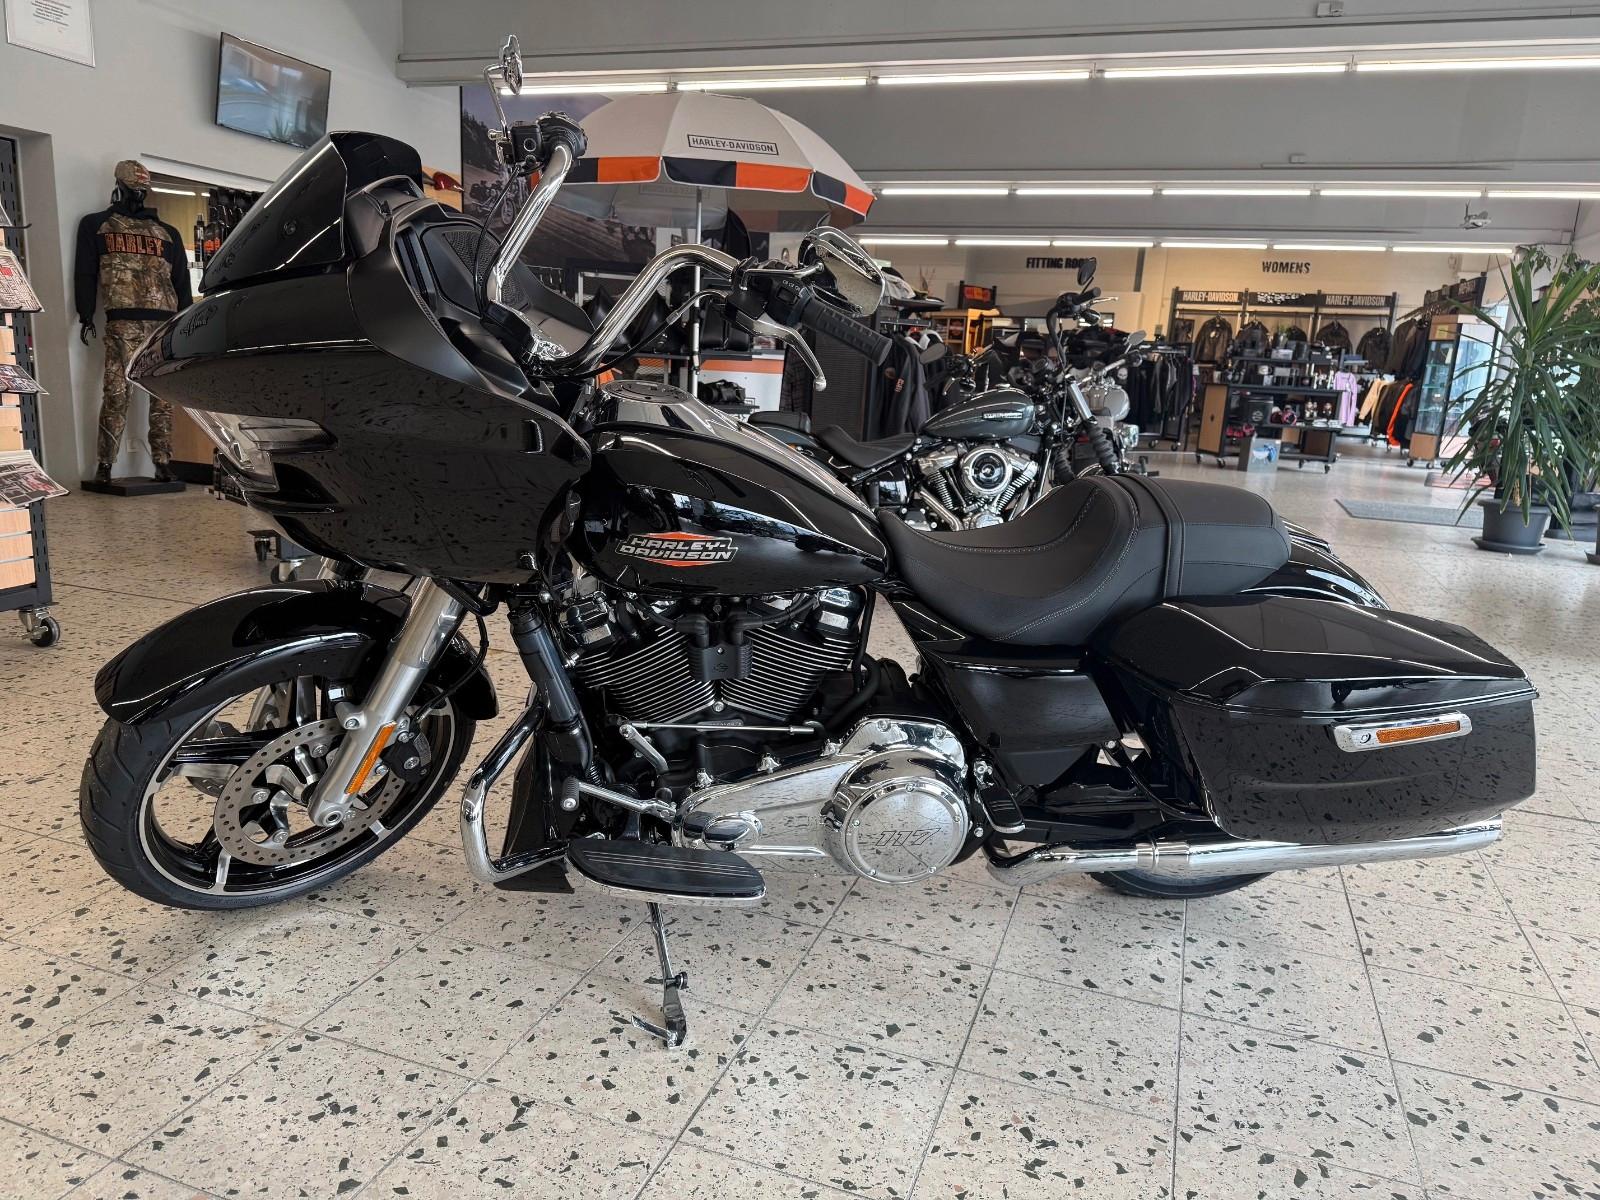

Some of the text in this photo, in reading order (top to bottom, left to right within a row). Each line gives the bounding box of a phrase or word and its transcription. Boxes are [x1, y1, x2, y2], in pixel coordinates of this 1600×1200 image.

[692, 137, 775, 152] HARLEY-DAVIDSON
[105, 233, 162, 257] HARLEY
[1026, 257, 1063, 270] FITTING
[1262, 261, 1311, 274] WOMENS
[1183, 291, 1239, 303] HARLEY-DAVIDSON
[1325, 294, 1386, 306] HARLEY-DAVIDSON
[631, 538, 726, 550] HARLEY-
[620, 545, 731, 560] DAVIDSON
[875, 827, 942, 847] 117
